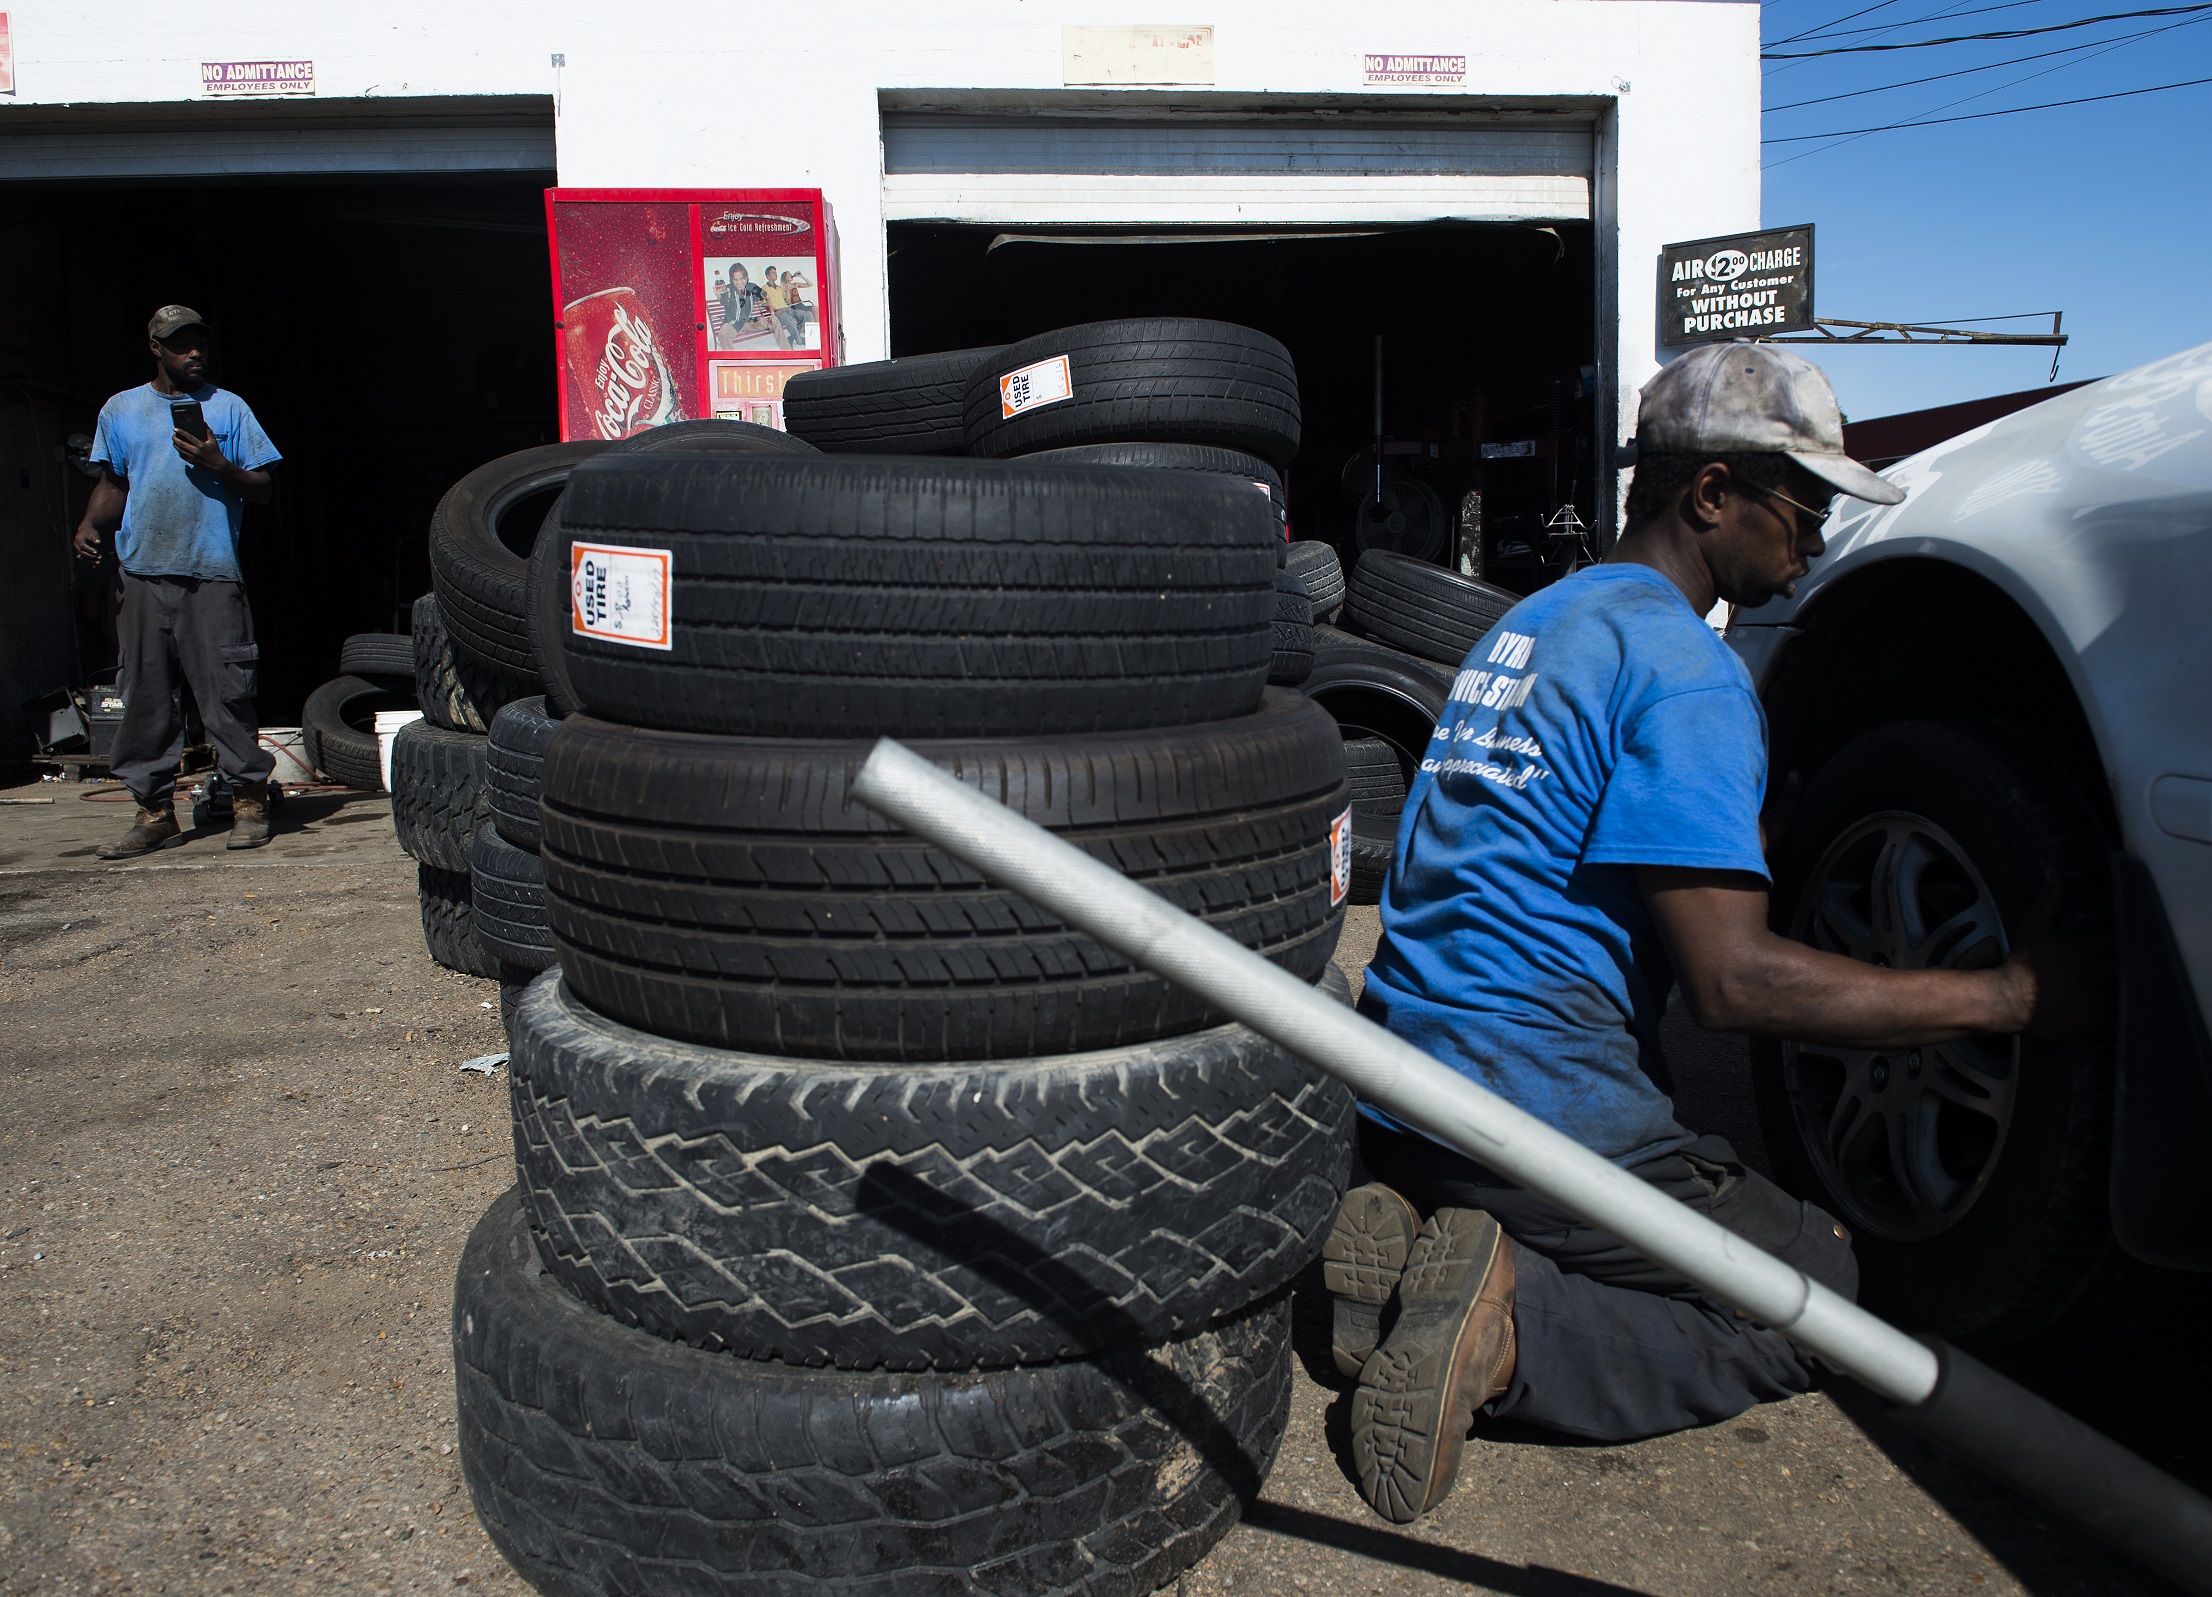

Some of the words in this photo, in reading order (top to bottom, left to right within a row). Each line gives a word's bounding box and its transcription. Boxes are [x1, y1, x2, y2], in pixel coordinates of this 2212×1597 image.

[203, 65, 222, 80] NO
[226, 63, 313, 80] ADMITTANCE
[1366, 57, 1383, 72] NO
[1386, 57, 1465, 73] ADMITTANCE
[1368, 74, 1431, 82] EMPLOYEES
[1435, 75, 1463, 83] ONLY
[206, 82, 276, 91] EMPLOYEES
[280, 81, 311, 90] ONLY
[723, 211, 744, 221] Enjoy
[727, 223, 738, 232] Ice
[740, 223, 752, 232] Cold
[755, 223, 793, 233] Refreshment
[1672, 259, 1704, 282] AIR
[1749, 246, 1801, 272] CHARGE
[1676, 287, 1697, 298] For
[1701, 283, 1726, 295] Any
[1731, 274, 1794, 290] Customer
[1691, 289, 1778, 314] WITHOUT
[1684, 305, 1786, 334] PURCHASE
[595, 360, 610, 390] Enjoy
[1020, 374, 1031, 403] TIRE
[643, 376, 661, 410] CLASSIC
[1012, 375, 1023, 408] USED
[585, 560, 595, 626] USED
[596, 566, 607, 622] TIRE
